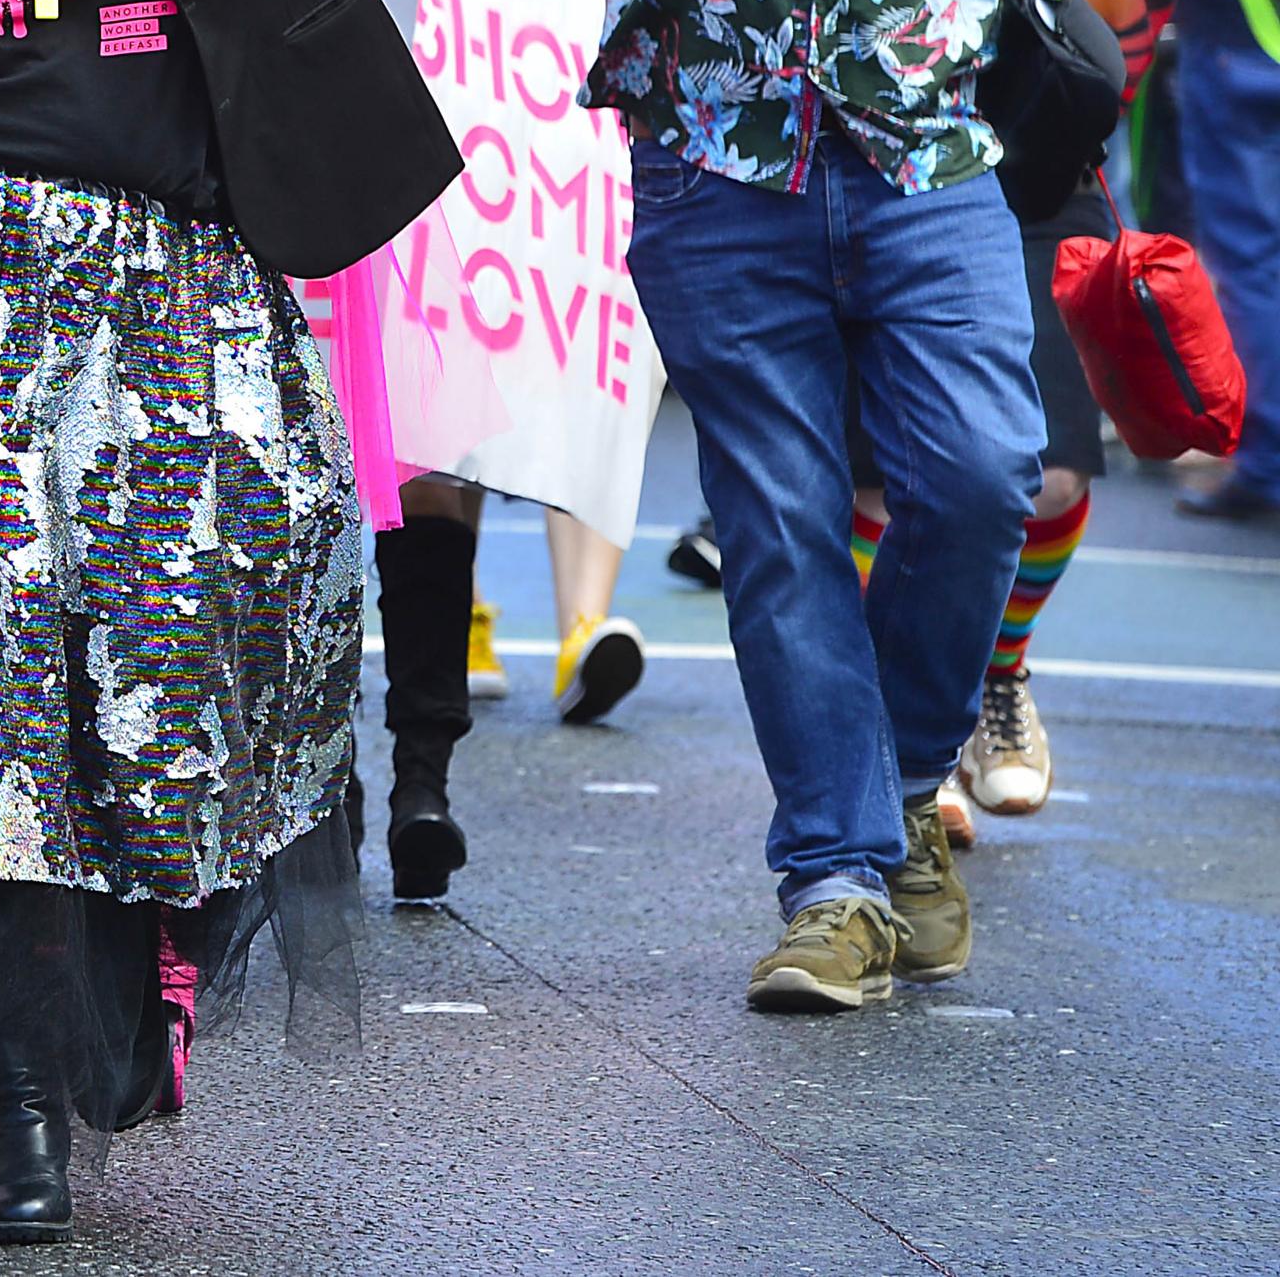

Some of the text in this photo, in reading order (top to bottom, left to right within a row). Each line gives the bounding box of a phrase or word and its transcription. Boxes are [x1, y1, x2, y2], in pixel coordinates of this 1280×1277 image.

[103, 3, 168, 19] ANOTHER
[104, 22, 151, 35] WORLD
[104, 39, 159, 53] BELFAST
[460, 125, 634, 276] OME
[403, 221, 635, 406] LOVE
